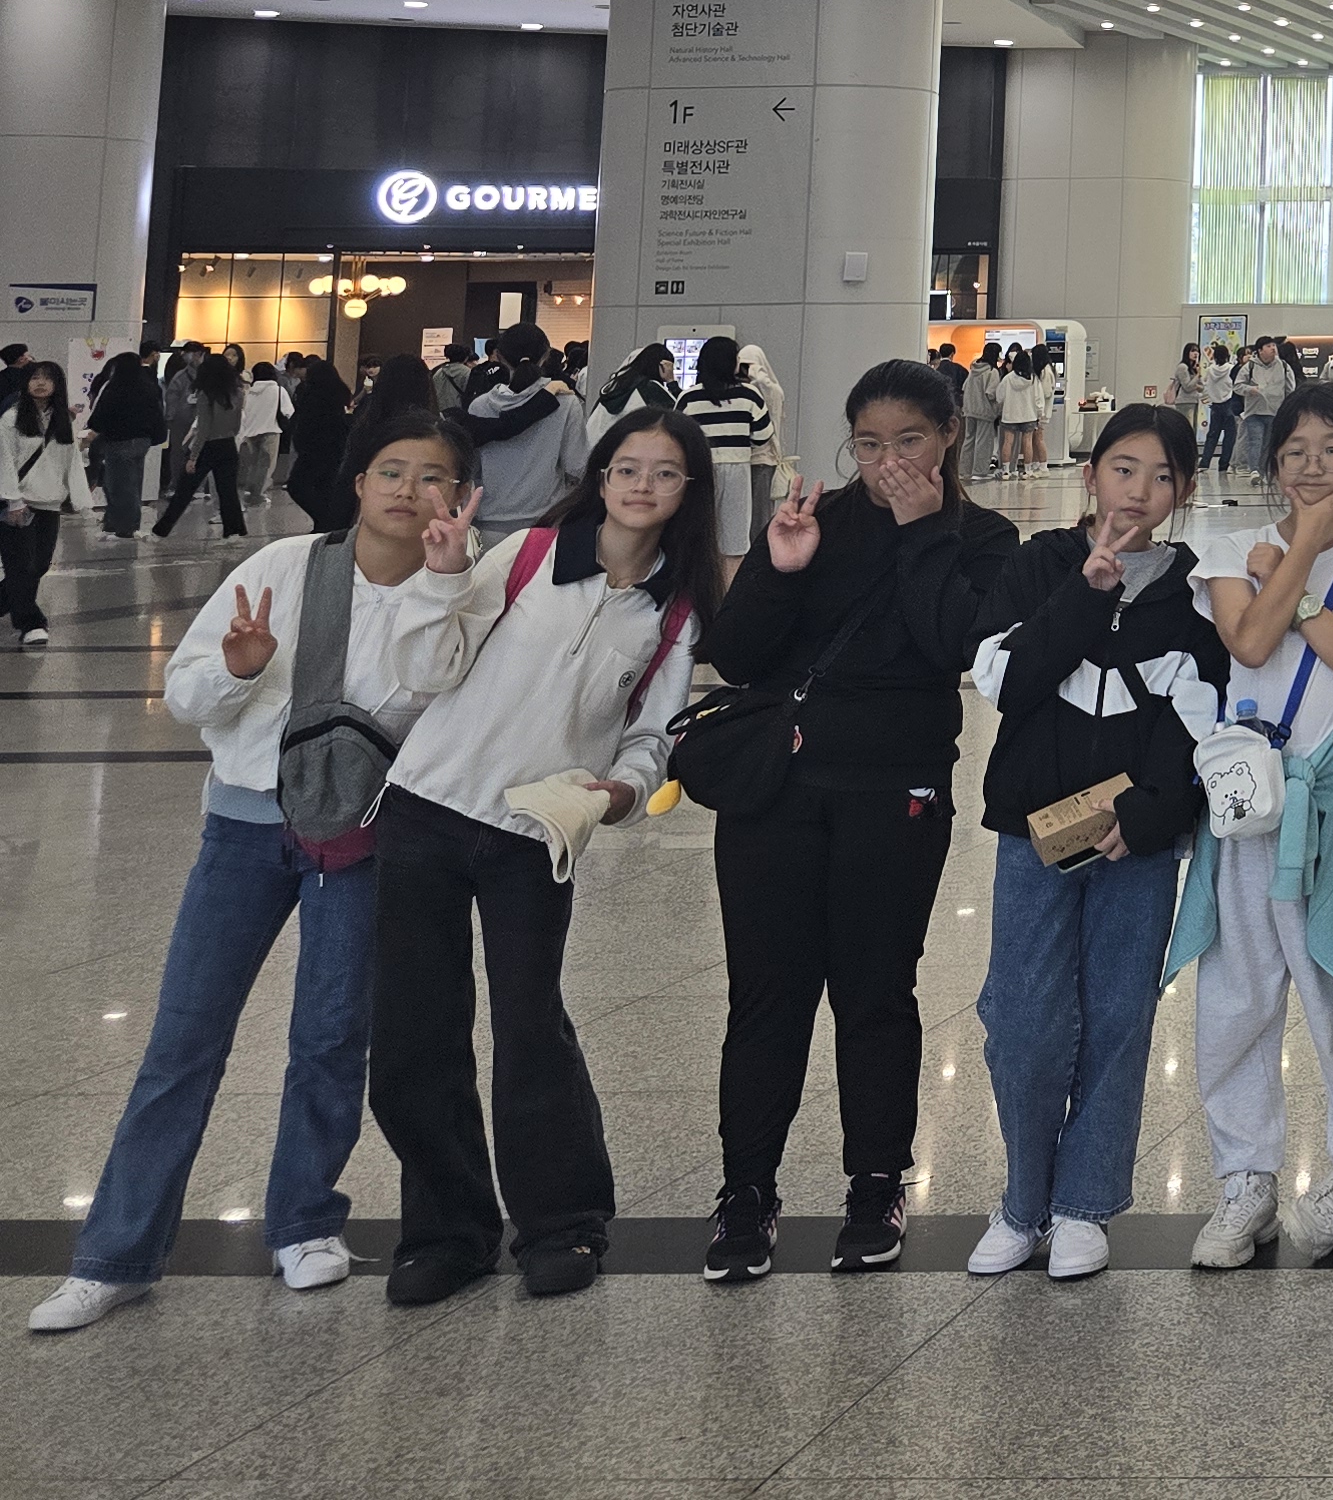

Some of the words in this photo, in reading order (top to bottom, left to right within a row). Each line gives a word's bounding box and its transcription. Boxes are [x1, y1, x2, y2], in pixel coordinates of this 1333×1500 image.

[671, 3, 727, 19] 자연사관
[670, 21, 739, 37] 첨단기술관
[669, 46, 694, 54] Natural
[695, 46, 719, 56] History
[720, 45, 734, 53] Hall
[703, 55, 729, 63] Science
[737, 54, 776, 64] Technology
[669, 99, 695, 124] 1F
[663, 138, 749, 155] 미래상상SF관
[661, 159, 730, 175] 특별전시관
[661, 179, 706, 190] 기획전시실
[660, 194, 705, 206] 명예의전당
[659, 209, 747, 221] 과학전시디자인연구실
